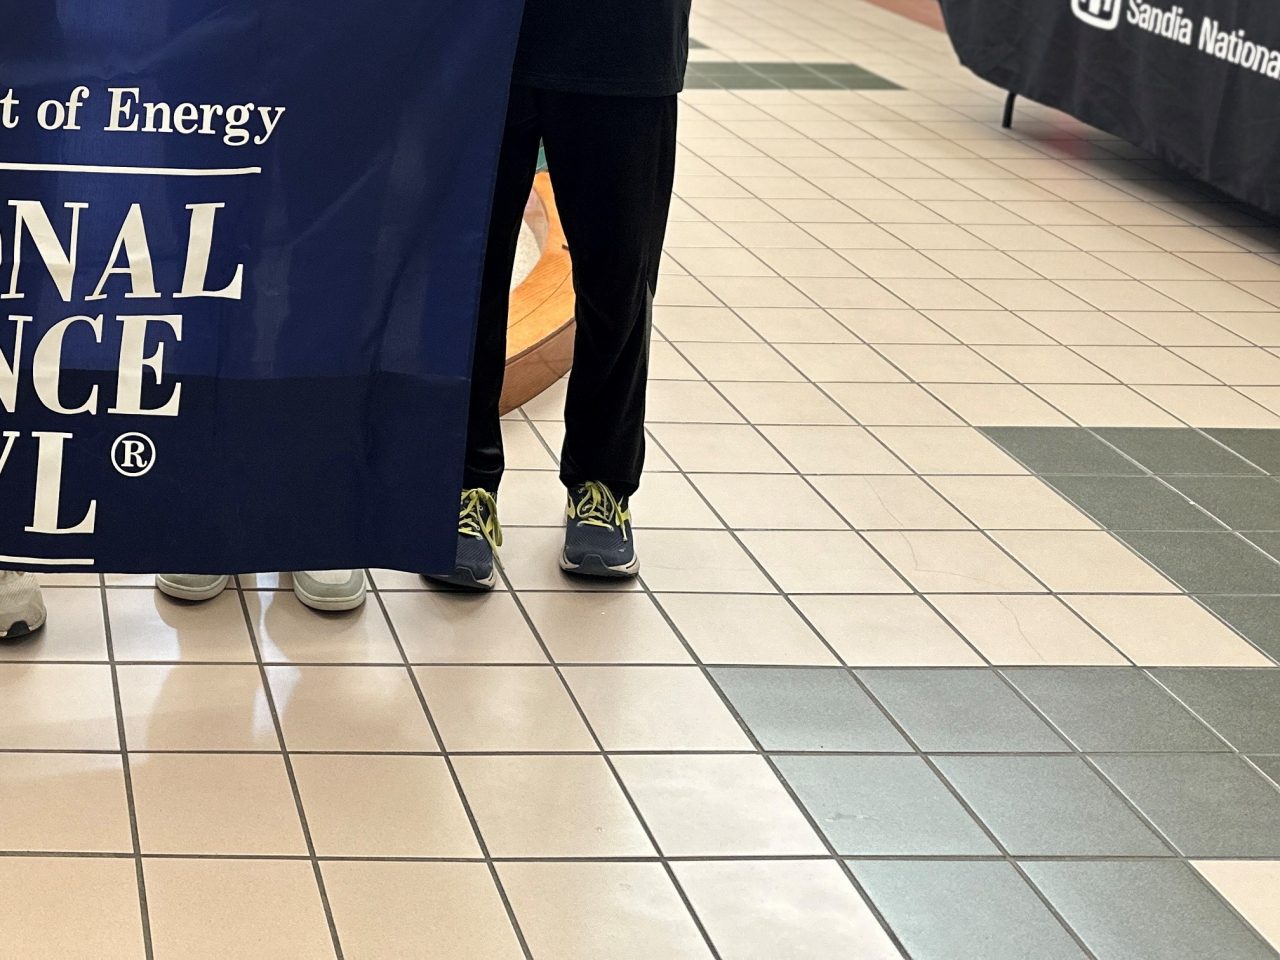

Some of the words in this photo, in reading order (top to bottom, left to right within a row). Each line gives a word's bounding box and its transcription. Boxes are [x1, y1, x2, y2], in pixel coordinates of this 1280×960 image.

[1198, 16, 1280, 80] Nationa
[38, 86, 89, 129] of
[104, 88, 285, 146] Energy
